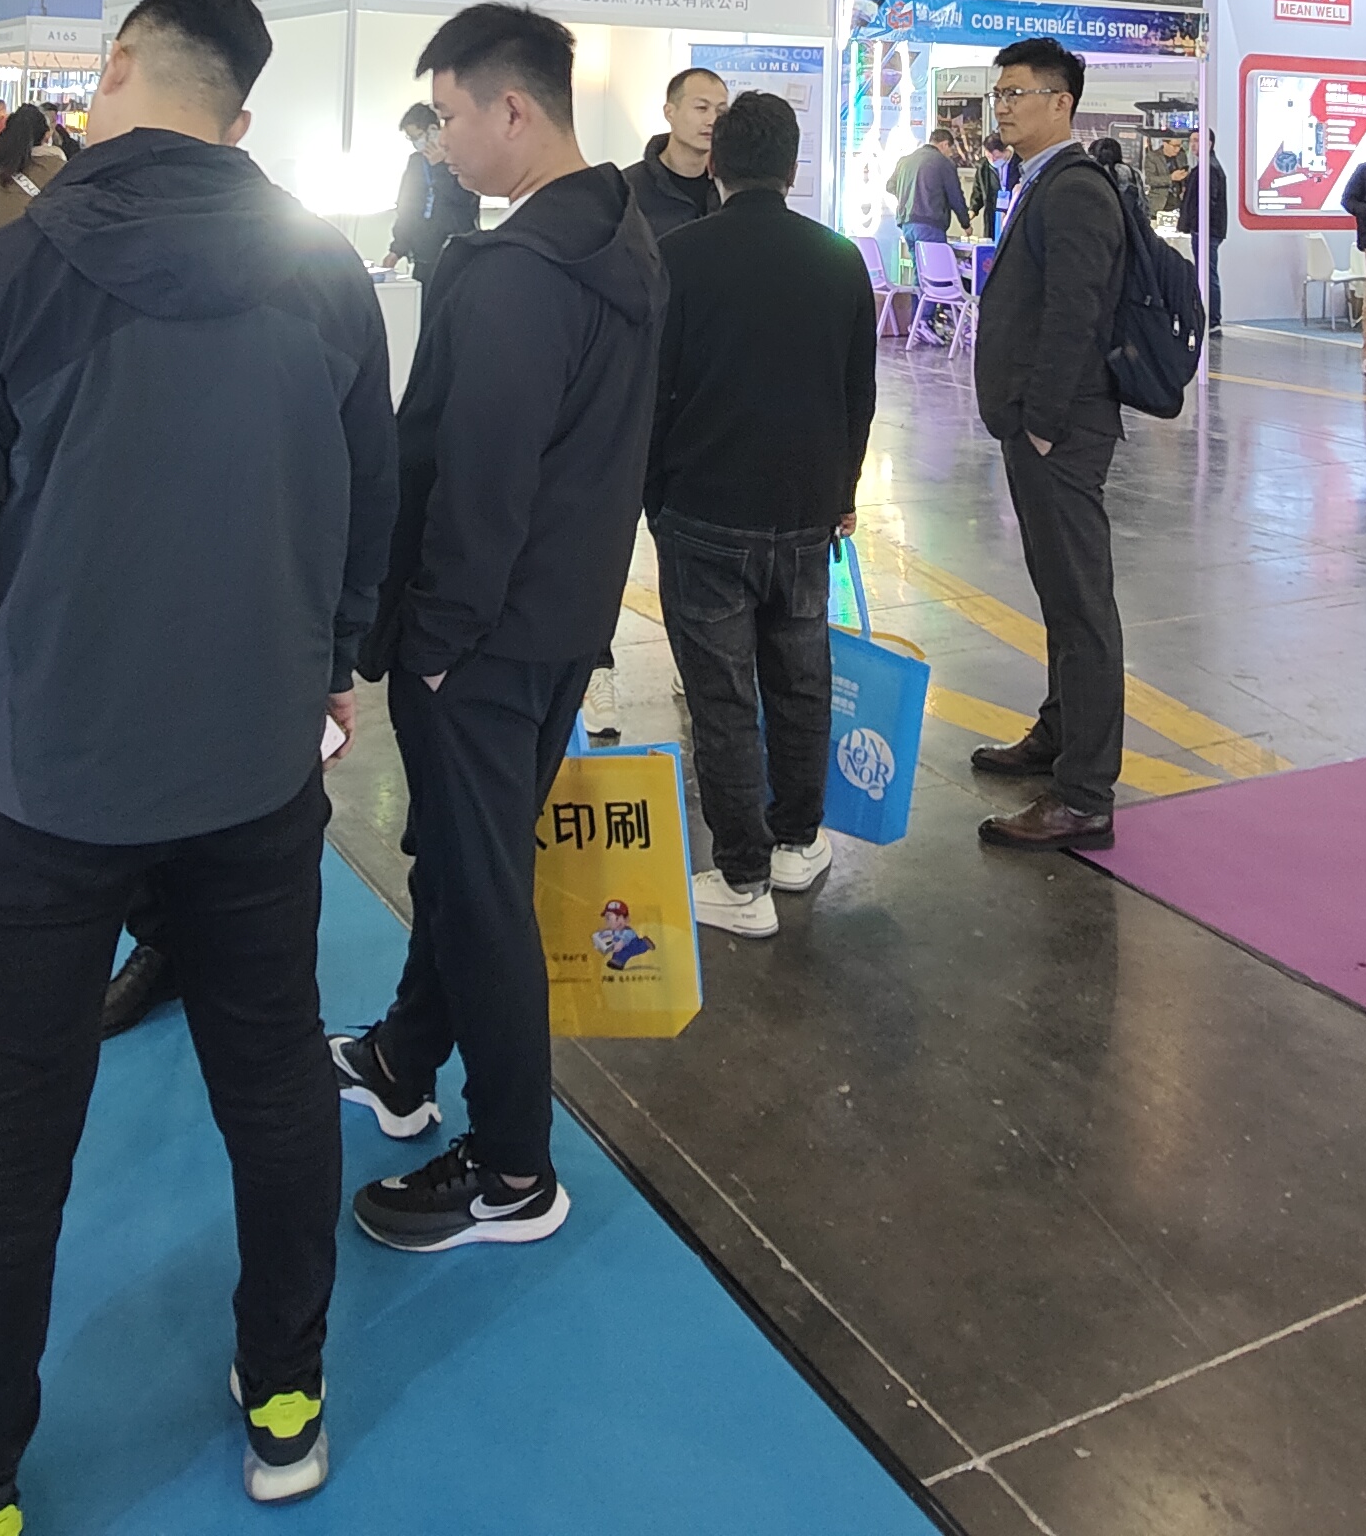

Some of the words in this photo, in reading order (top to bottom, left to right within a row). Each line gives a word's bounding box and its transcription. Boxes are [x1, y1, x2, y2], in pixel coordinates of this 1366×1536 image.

[1280, 3, 1312, 17] MEAN
[1316, 6, 1345, 19] WELL
[971, 14, 1003, 31] COB
[1006, 16, 1075, 35] FLEXIBLE
[1078, 21, 1105, 37] LED
[1108, 23, 1149, 40] STRIP
[47, 30, 77, 41] A165
[750, 61, 800, 72] LUMEN
